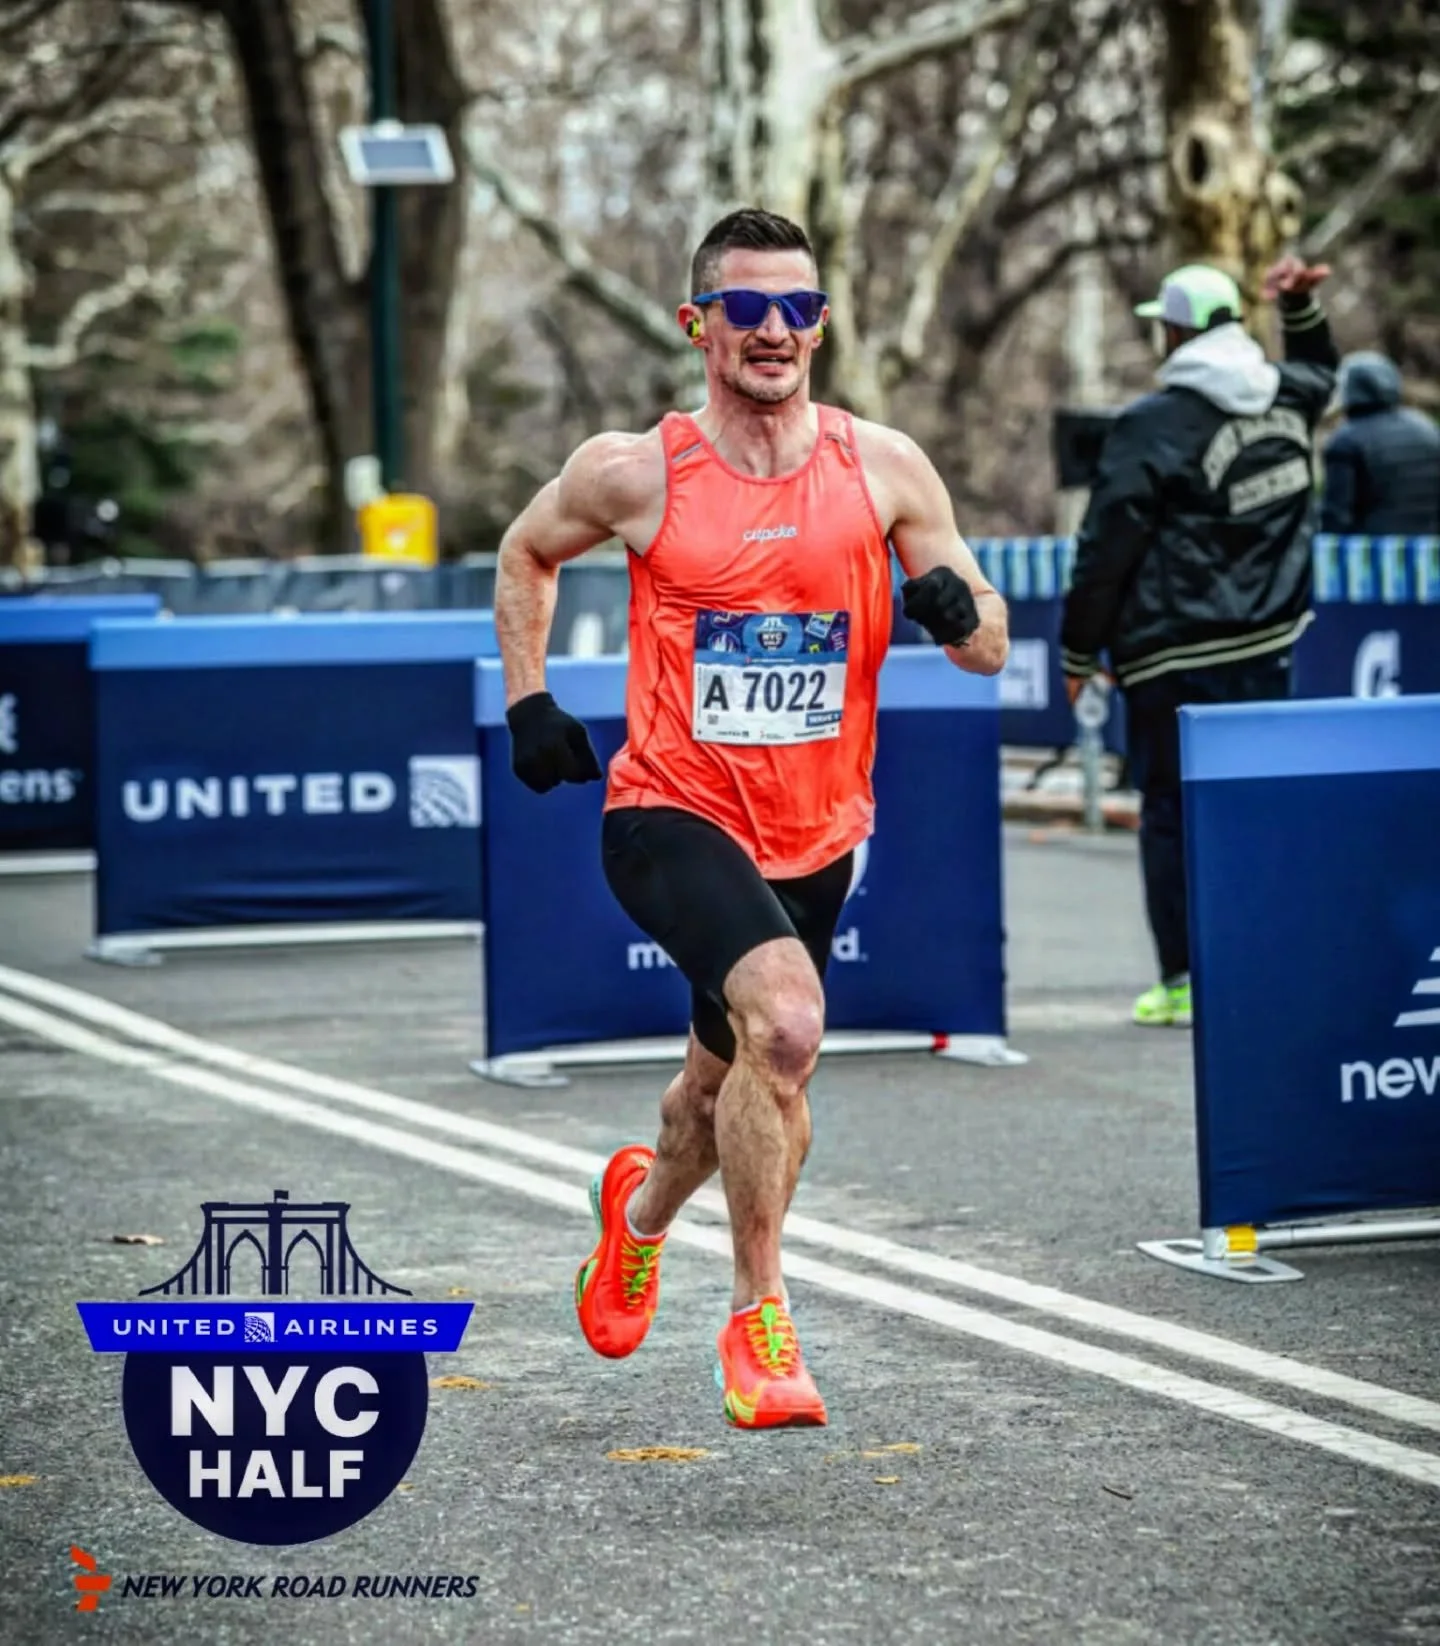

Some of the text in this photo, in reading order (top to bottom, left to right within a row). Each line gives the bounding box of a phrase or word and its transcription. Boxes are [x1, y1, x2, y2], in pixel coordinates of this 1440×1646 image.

[702, 674, 730, 711] A
[742, 670, 826, 713] 7022
[122, 771, 397, 823] UNITED
